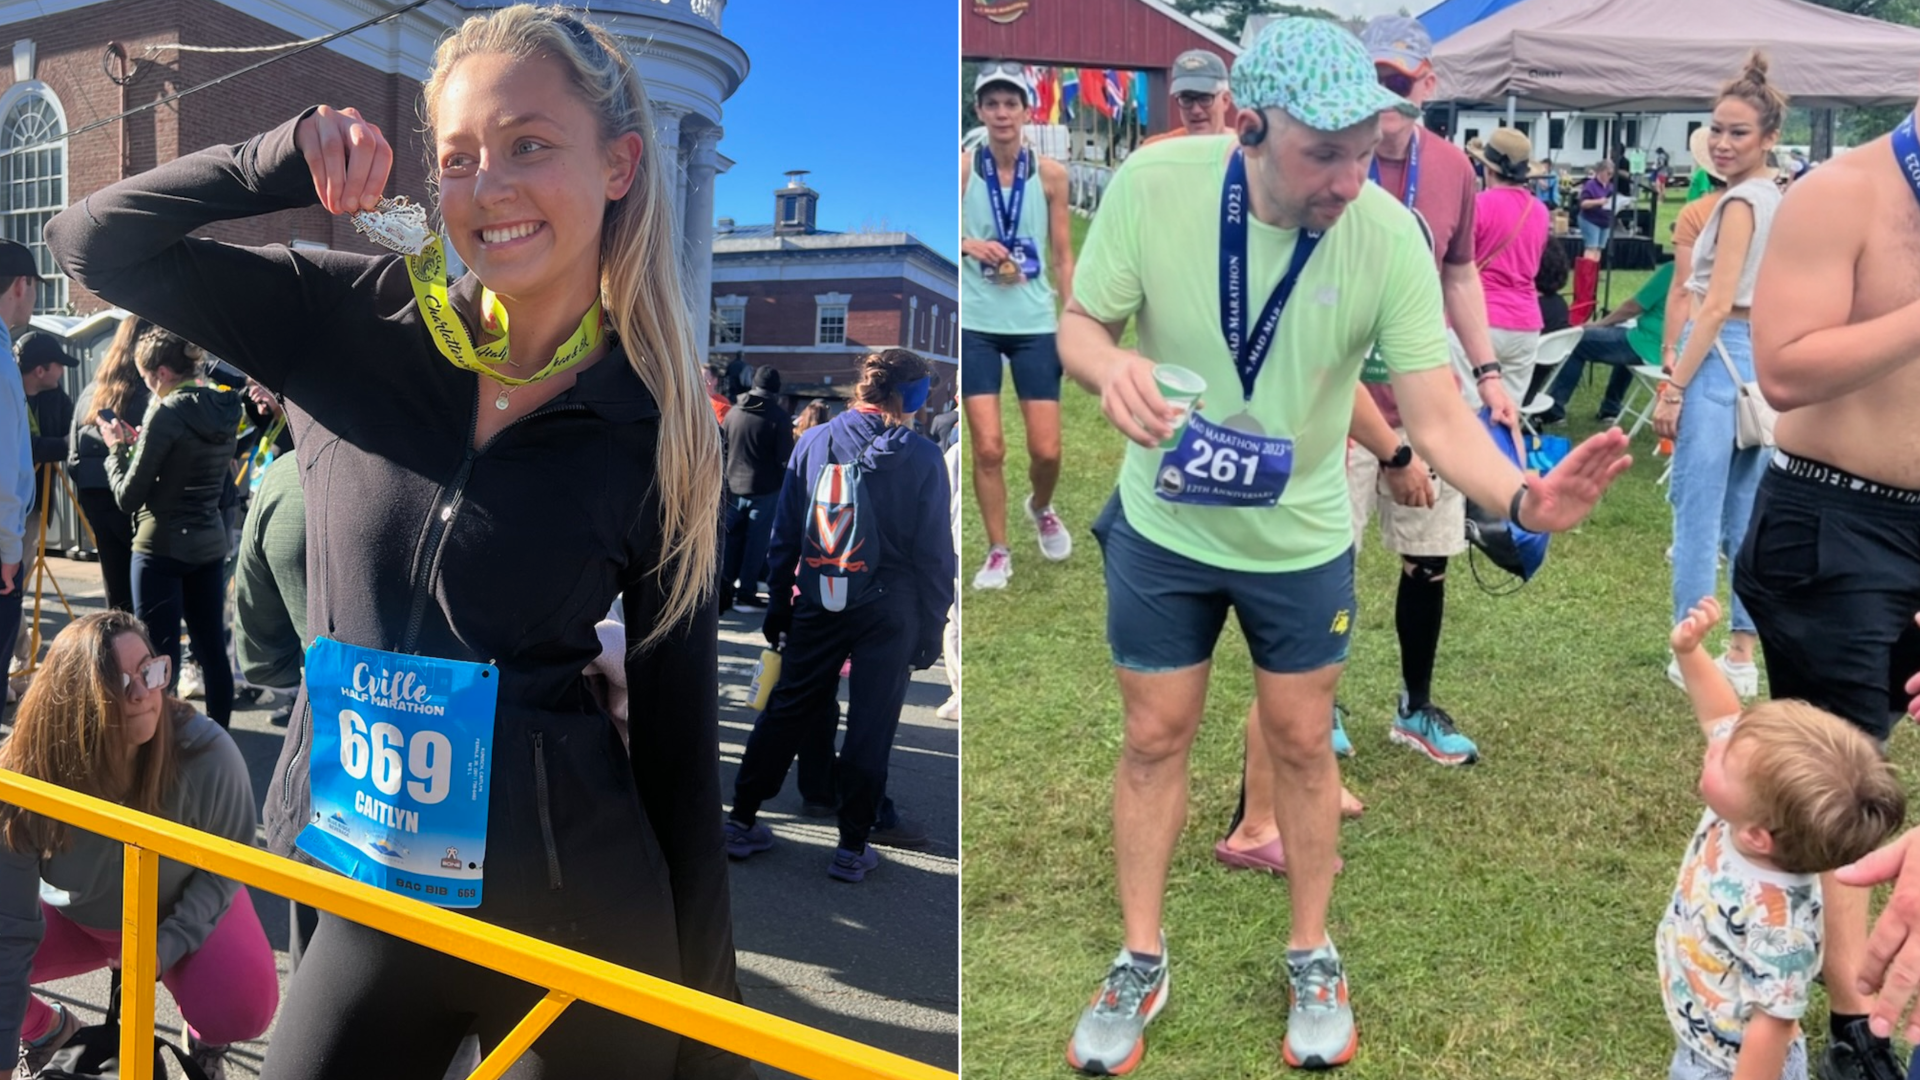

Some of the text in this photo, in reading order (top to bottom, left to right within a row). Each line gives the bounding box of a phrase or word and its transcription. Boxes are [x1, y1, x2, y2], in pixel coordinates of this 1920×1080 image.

[1227, 184, 1242, 224] 2023
[1229, 255, 1240, 331] MARATHON
[1205, 427, 1261, 453] MARATHON
[1184, 439, 1259, 486] 261
[1187, 484, 1210, 493] 12TH
[341, 687, 445, 717] HALF MARATHON
[353, 662, 433, 704] Cville
[338, 708, 452, 804] 669
[355, 790, 419, 834] CAITLYN
[426, 885, 448, 896] BIB
[457, 889, 476, 898] 669
